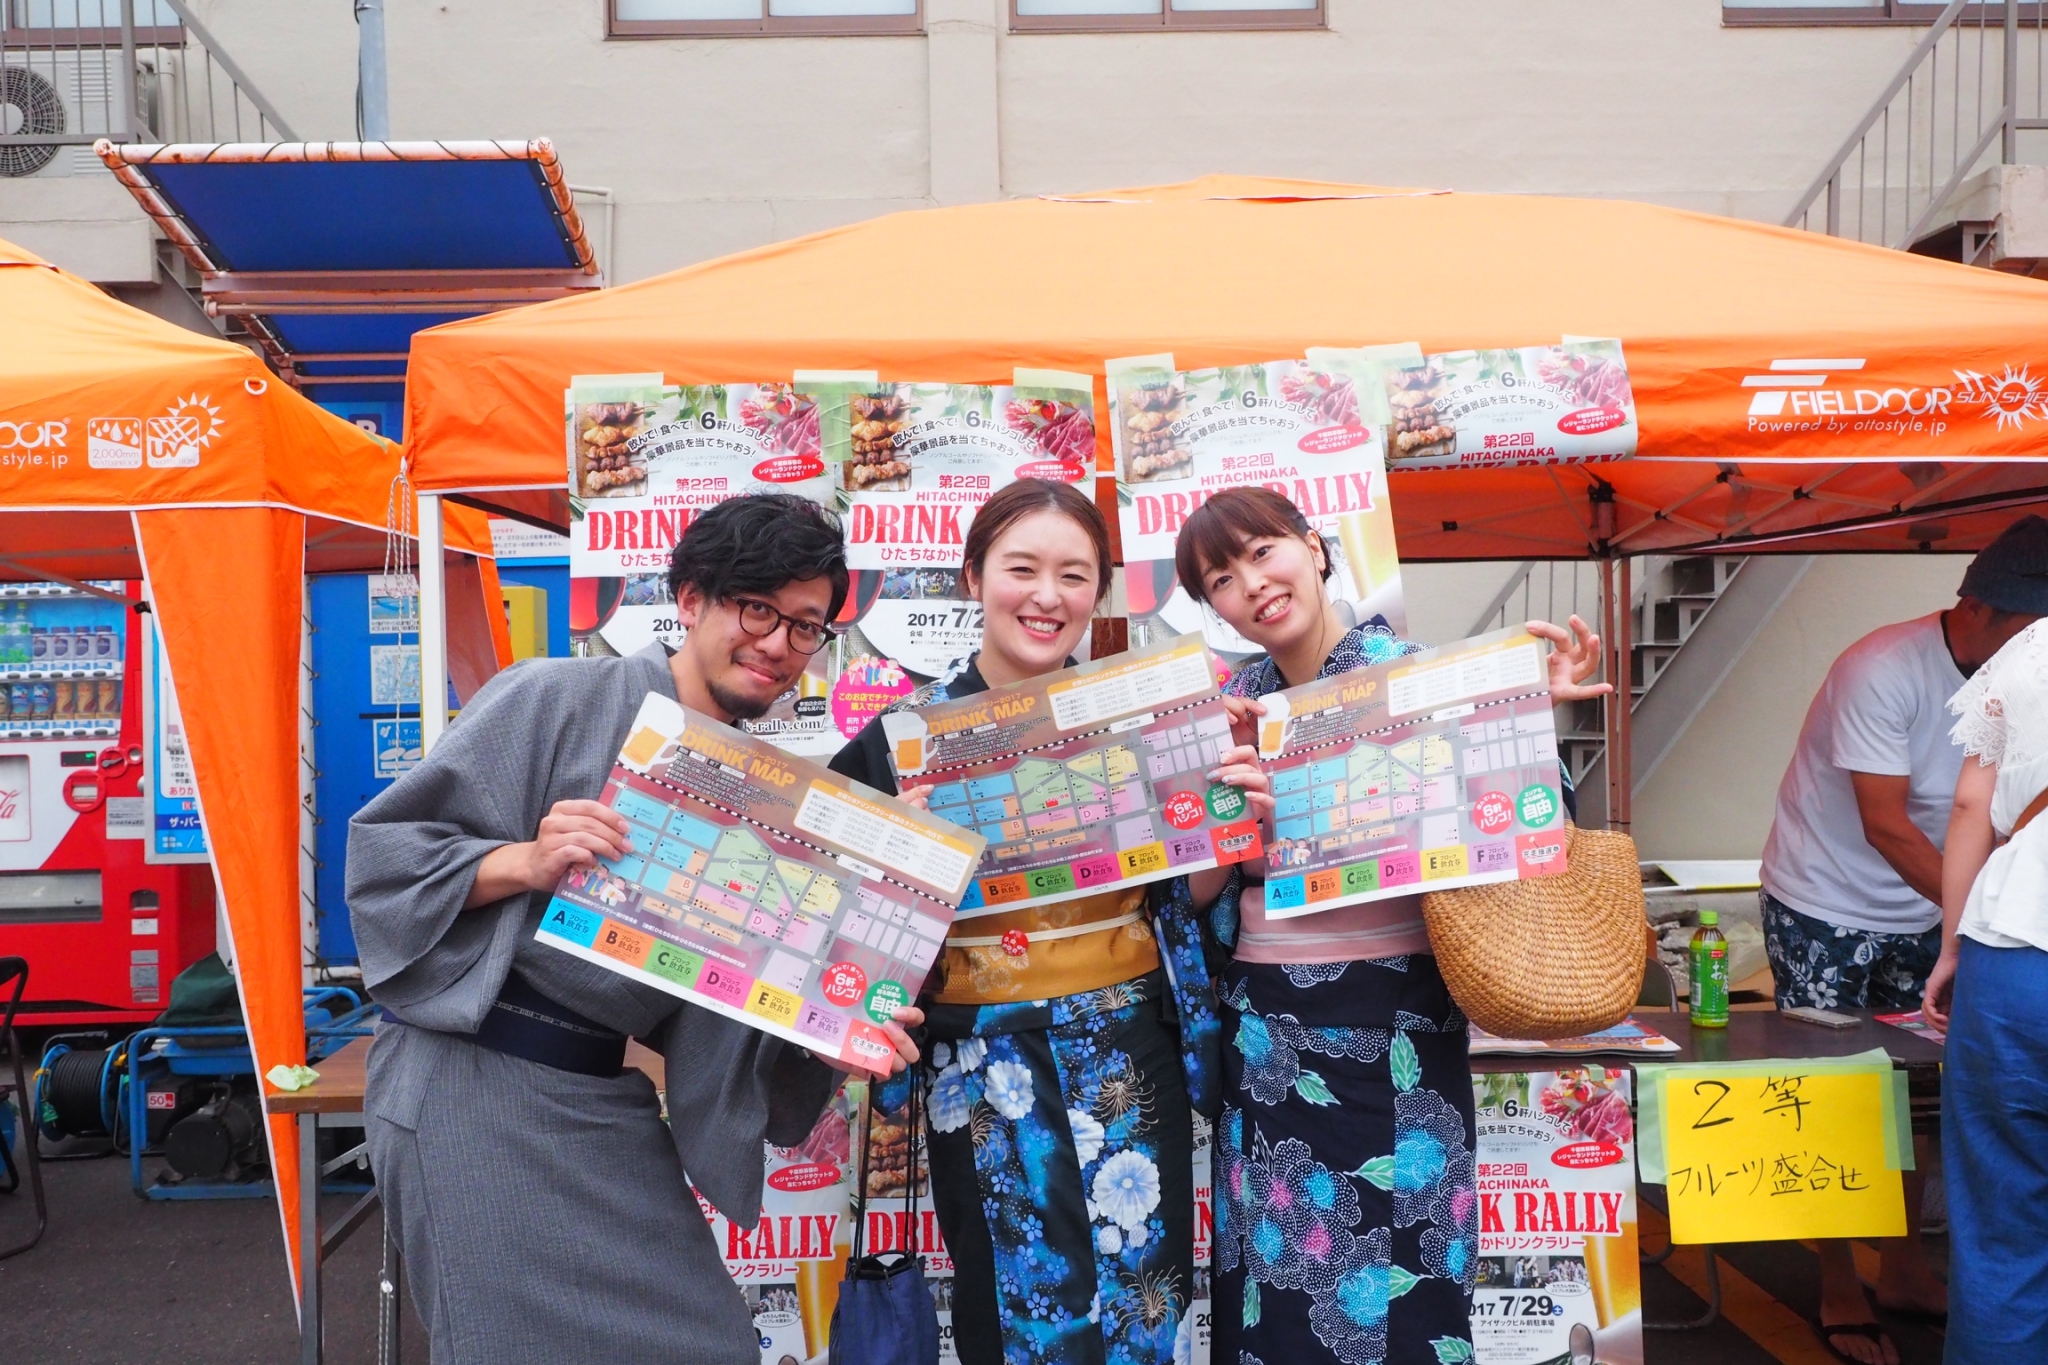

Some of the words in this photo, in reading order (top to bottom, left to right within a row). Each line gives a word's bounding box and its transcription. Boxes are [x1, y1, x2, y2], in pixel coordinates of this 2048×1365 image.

[1453, 395, 1559, 420] 豪華景品を当てちゃおう!
[1790, 387, 1949, 415] FIELDOOR
[1188, 416, 1300, 444] 豪華景品を当てちゃおう!
[1748, 418, 1821, 433] Powered
[1827, 417, 1848, 434] by
[1854, 417, 1947, 436] ottostyle.jp
[910, 435, 1019, 458] 豪華景品を当てちゃおう!
[1483, 432, 1535, 449] 第22回
[93, 449, 139, 459] 2,000mm
[645, 437, 756, 462] 豪華景品を当てちゃおう!
[1460, 447, 1556, 462] HITACHINAKA
[0, 449, 68, 469] style.jp
[1221, 452, 1275, 471] 第22回
[938, 475, 990, 489] 第22回
[1201, 466, 1299, 487] HITACHINAKA
[675, 477, 728, 492] 第22回
[850, 504, 963, 545] DRINK
[907, 613, 947, 627] 2017
[838, 692, 901, 702] このお店でチケット
[1291, 692, 1340, 717] DRINK
[1343, 681, 1377, 703] MAP
[929, 711, 993, 735] DRINK
[995, 697, 1036, 720] MAP
[681, 728, 748, 771] DRINK
[750, 757, 797, 788] MAP
[1174, 801, 1192, 813] 6軒
[1213, 793, 1241, 815] 自由
[1483, 803, 1502, 816] 6軒
[1522, 799, 1553, 821] 自由
[1173, 806, 1203, 826] ハシゴ!
[1480, 811, 1512, 829] ハシゴ!
[1174, 844, 1182, 856] F
[1128, 855, 1136, 867] E
[1080, 867, 1091, 879] D
[1035, 876, 1045, 888] C
[989, 885, 999, 896] B
[1272, 888, 1282, 899] A
[552, 910, 565, 925] A
[570, 914, 589, 925] ブロック
[566, 920, 590, 934] 飲食券
[605, 930, 617, 945] B
[622, 935, 640, 946] ブロック
[618, 941, 641, 955] 飲食券
[657, 952, 670, 966] C
[672, 955, 691, 966] ブロック
[668, 962, 692, 976] 飲食券
[706, 971, 720, 985] D
[722, 975, 741, 986] ブロック
[835, 973, 856, 988] 6軒
[719, 982, 742, 996] 飲食券
[825, 984, 863, 1001] ハシゴ!
[758, 992, 769, 1006] E
[772, 995, 790, 1006] ブロック
[870, 996, 901, 1013] 自由
[769, 1001, 791, 1016] 飲食券
[807, 1011, 817, 1024] F
[821, 1015, 838, 1025] ブロック
[817, 1021, 840, 1035] 飲食券
[1478, 1163, 1528, 1177] 第22回
[1671, 1151, 1870, 1197] フルーツ盛合せ
[1476, 1179, 1550, 1190] ACHINAKA
[1514, 1191, 1623, 1233] RALLY
[1480, 1236, 1585, 1250] かドリンクラリー
[1499, 1296, 1553, 1317] 7/29
[1480, 1319, 1555, 1327] アイザックビル前駐車場
